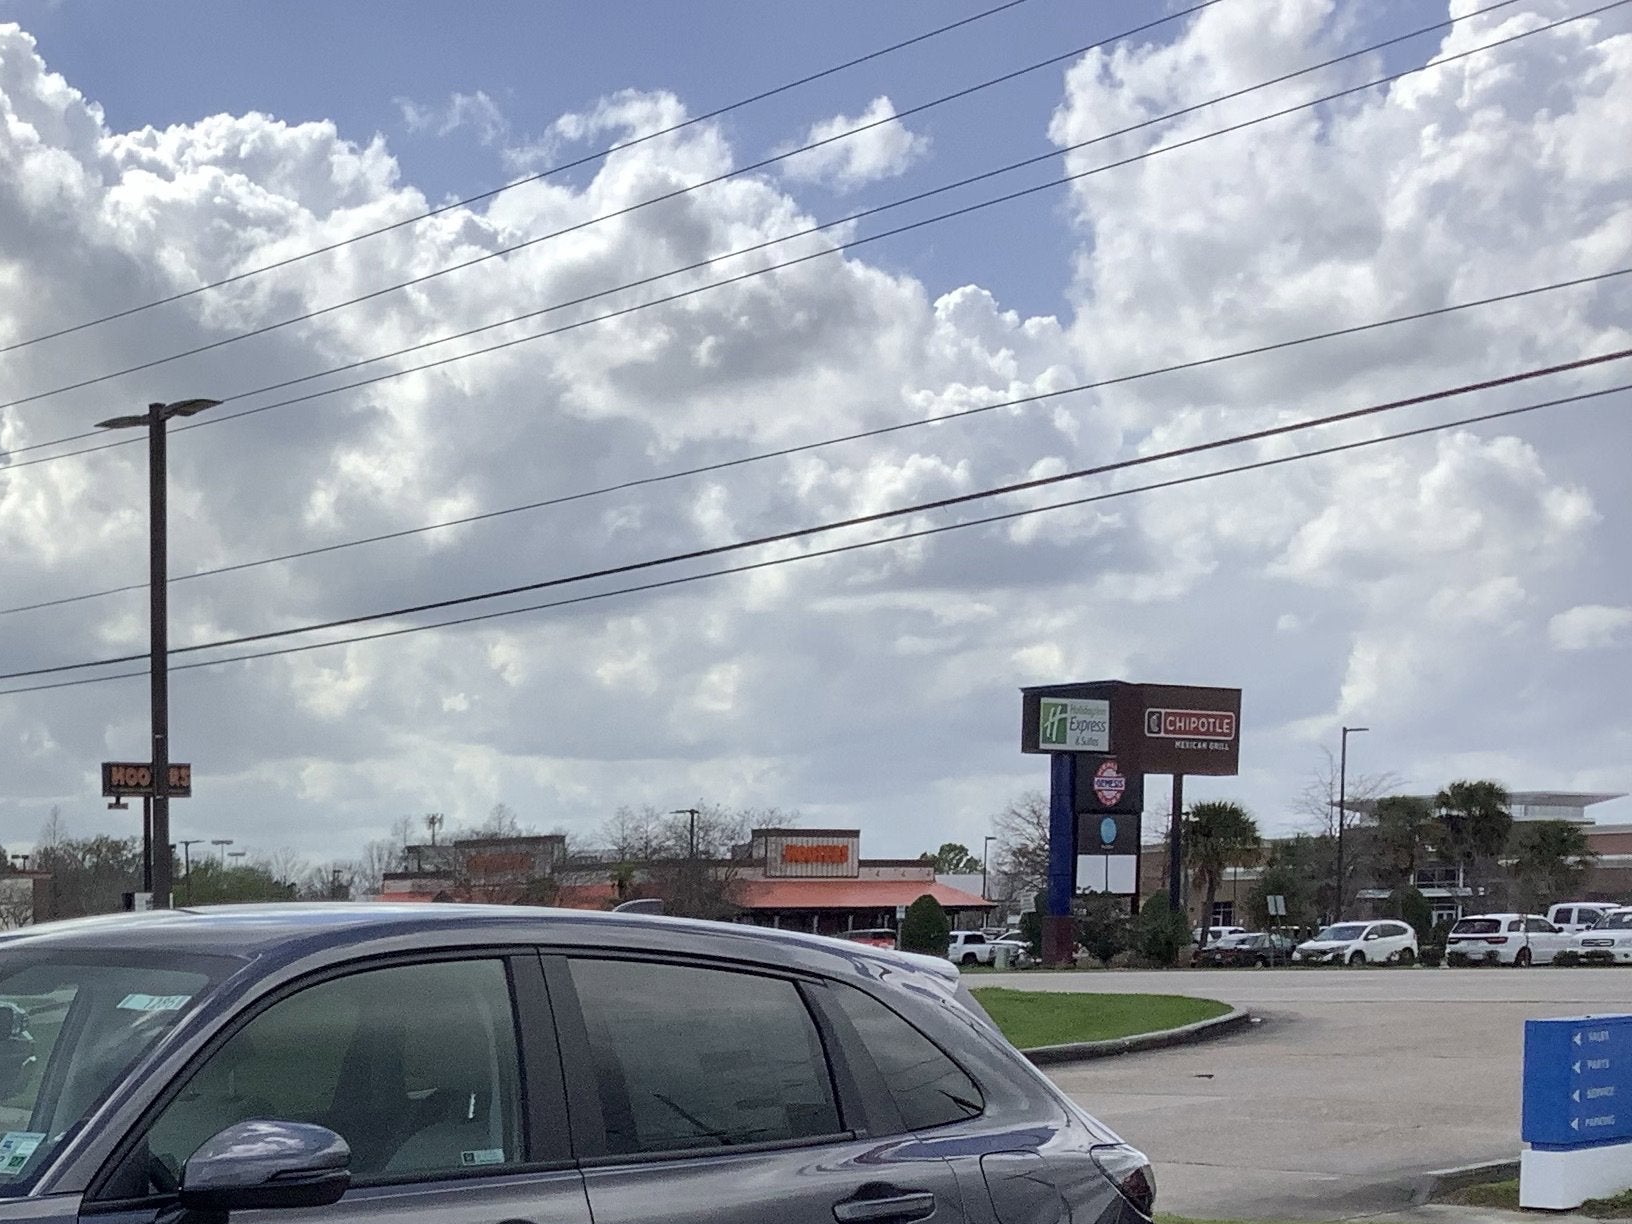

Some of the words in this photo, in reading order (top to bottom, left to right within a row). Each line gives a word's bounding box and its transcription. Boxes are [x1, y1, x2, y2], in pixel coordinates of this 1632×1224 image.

[1069, 716, 1106, 734] Express
[1166, 716, 1231, 733] CHIPOTLE
[1174, 741, 1207, 750] MEXICAN
[1208, 742, 1230, 751] GRILL
[111, 766, 190, 787] HOORS
